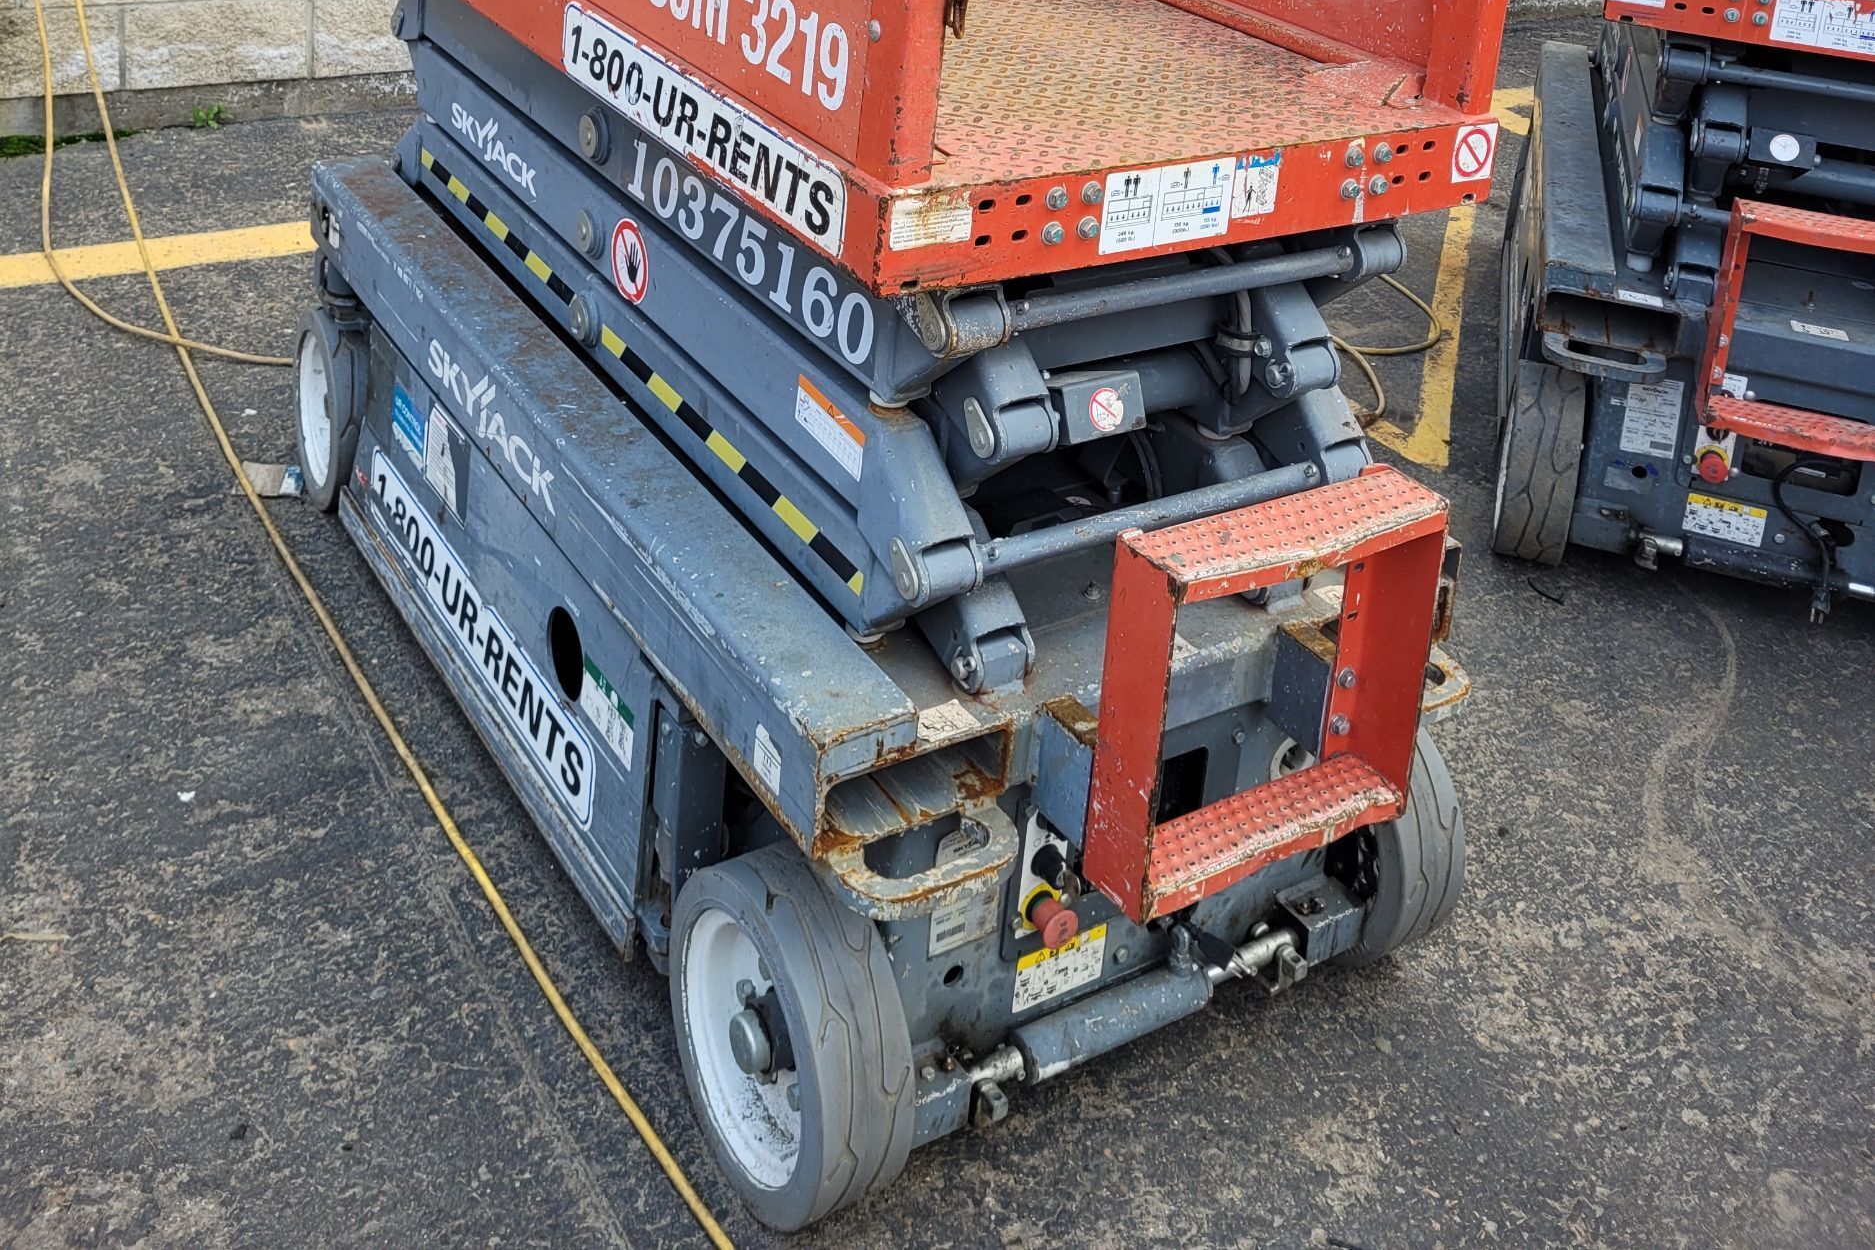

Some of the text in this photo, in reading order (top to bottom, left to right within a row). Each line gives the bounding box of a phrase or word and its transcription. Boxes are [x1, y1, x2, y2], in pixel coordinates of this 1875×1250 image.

[451, 102, 537, 198] SKYJACK
[570, 24, 834, 237] 1-800-UR-RENTS
[626, 141, 875, 365] 10375160
[427, 338, 557, 517] SKYJACK
[378, 473, 584, 797] 1-800-UR-RENTS
